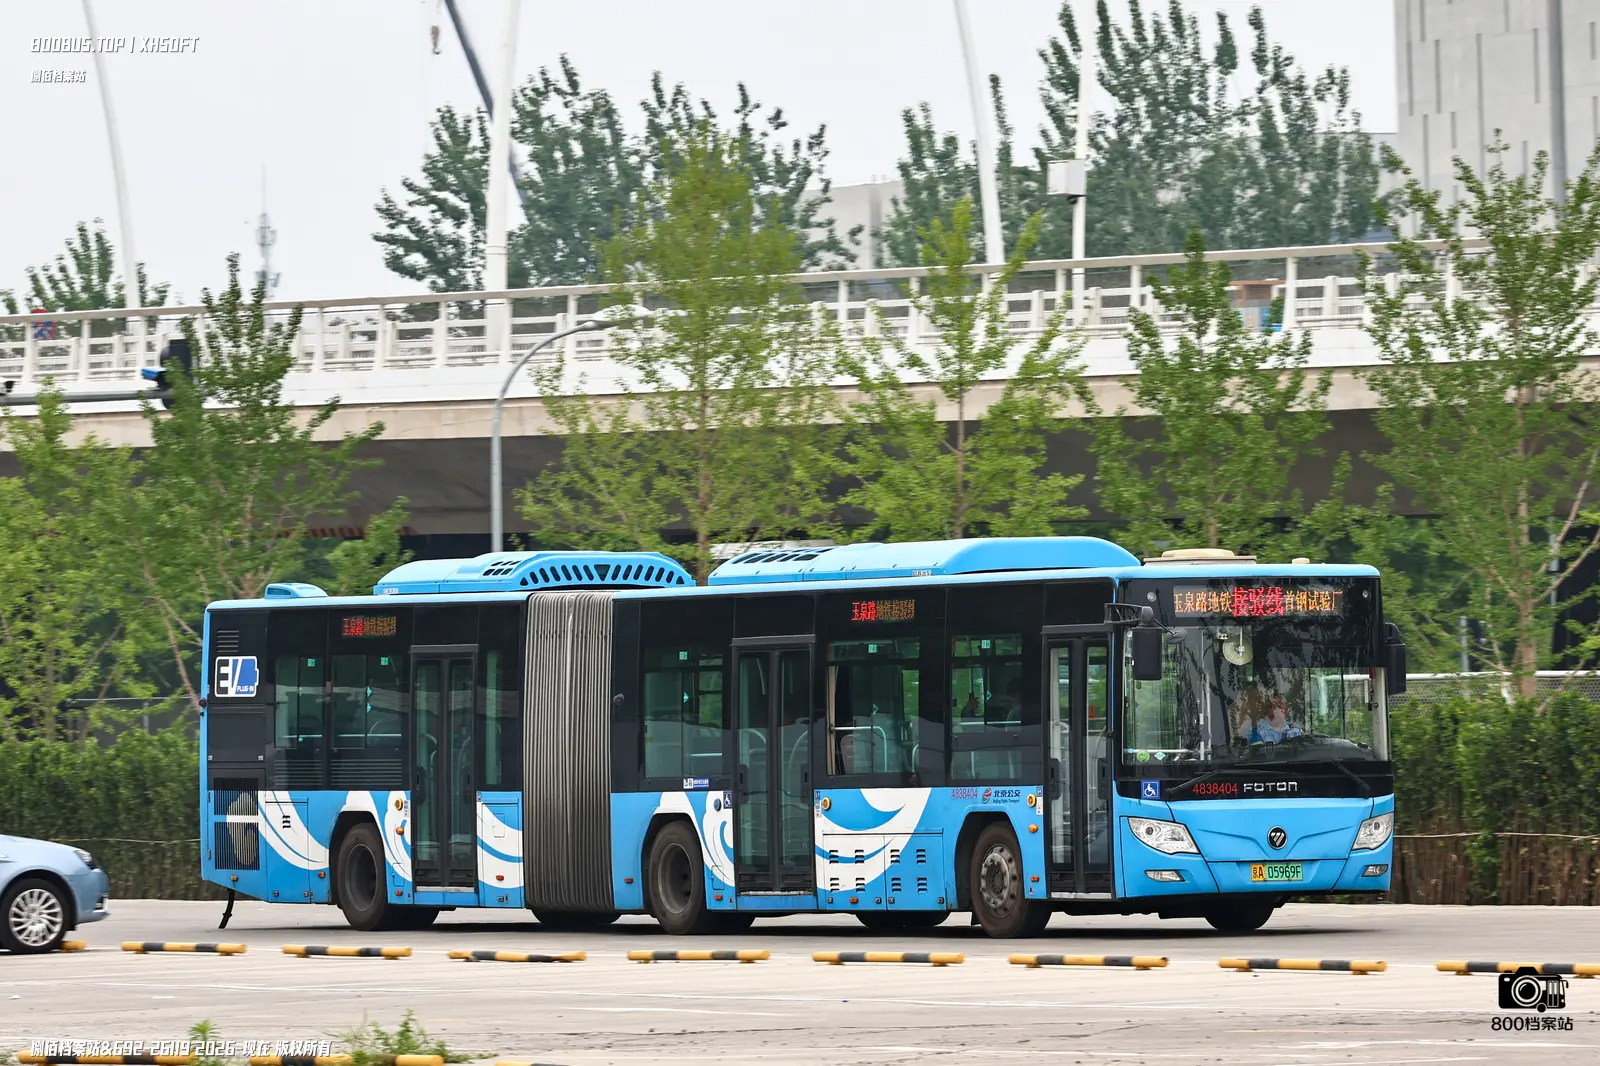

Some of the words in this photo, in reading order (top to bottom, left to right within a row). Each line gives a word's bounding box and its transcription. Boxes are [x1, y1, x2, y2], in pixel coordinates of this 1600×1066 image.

[951, 787, 978, 800] 4838404
[993, 789, 1021, 798] 北京公交
[1192, 783, 1239, 795] 4838404
[1243, 781, 1298, 793] FOTON
